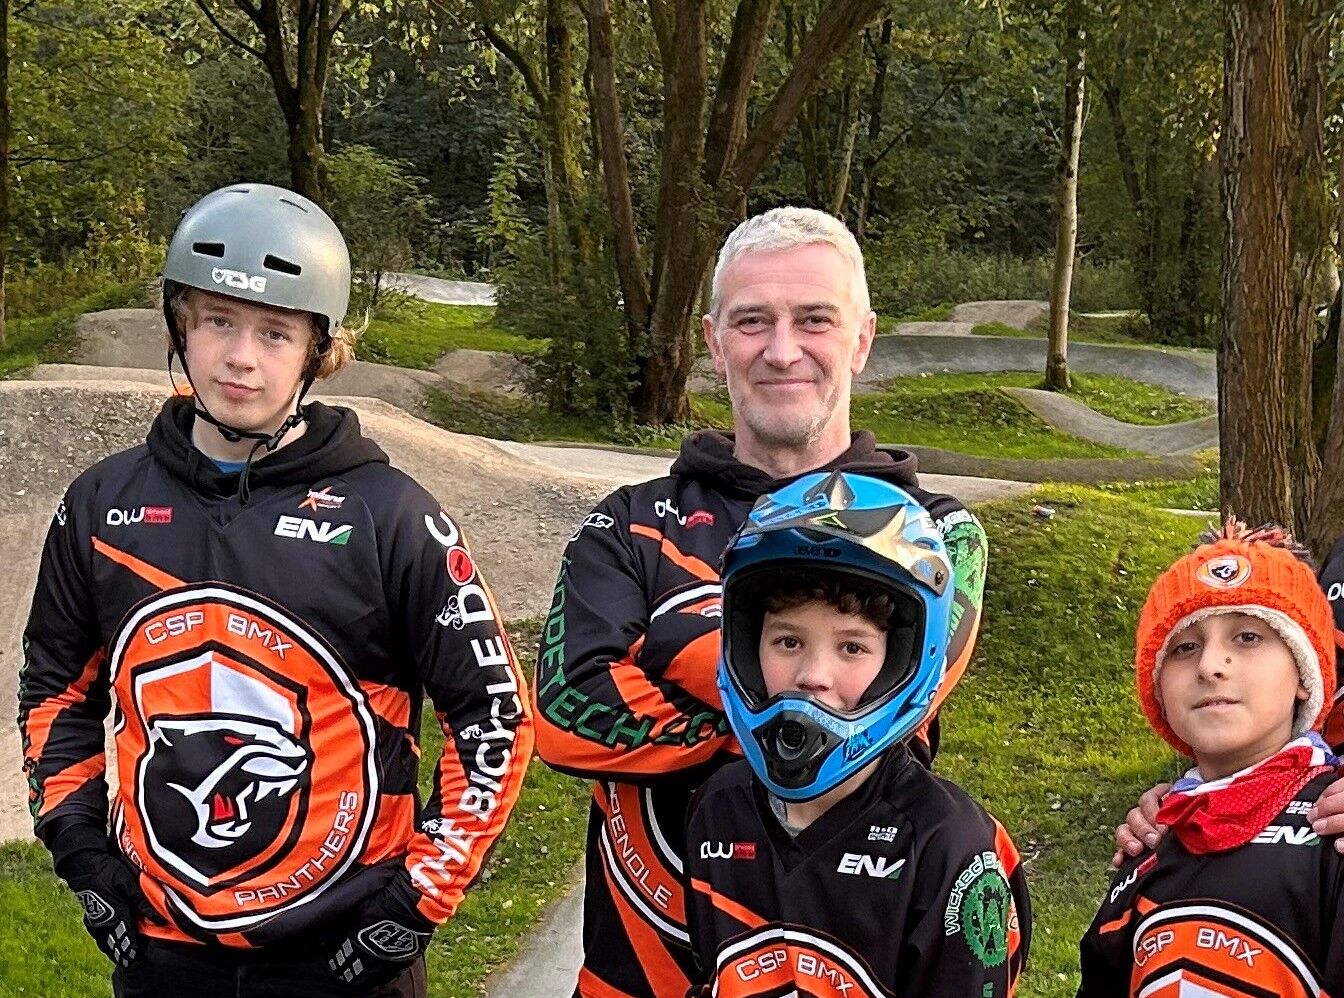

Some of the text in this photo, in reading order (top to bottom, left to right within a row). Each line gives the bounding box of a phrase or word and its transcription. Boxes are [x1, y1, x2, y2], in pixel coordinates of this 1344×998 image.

[274, 515, 354, 545] ENV
[144, 610, 294, 660] CSP BMX
[458, 636, 524, 822] BICYCLE
[235, 790, 359, 907] PANTHERS
[837, 852, 906, 880] ENV
[1196, 928, 1262, 967] BMX
[735, 949, 854, 998] CSP BMX
